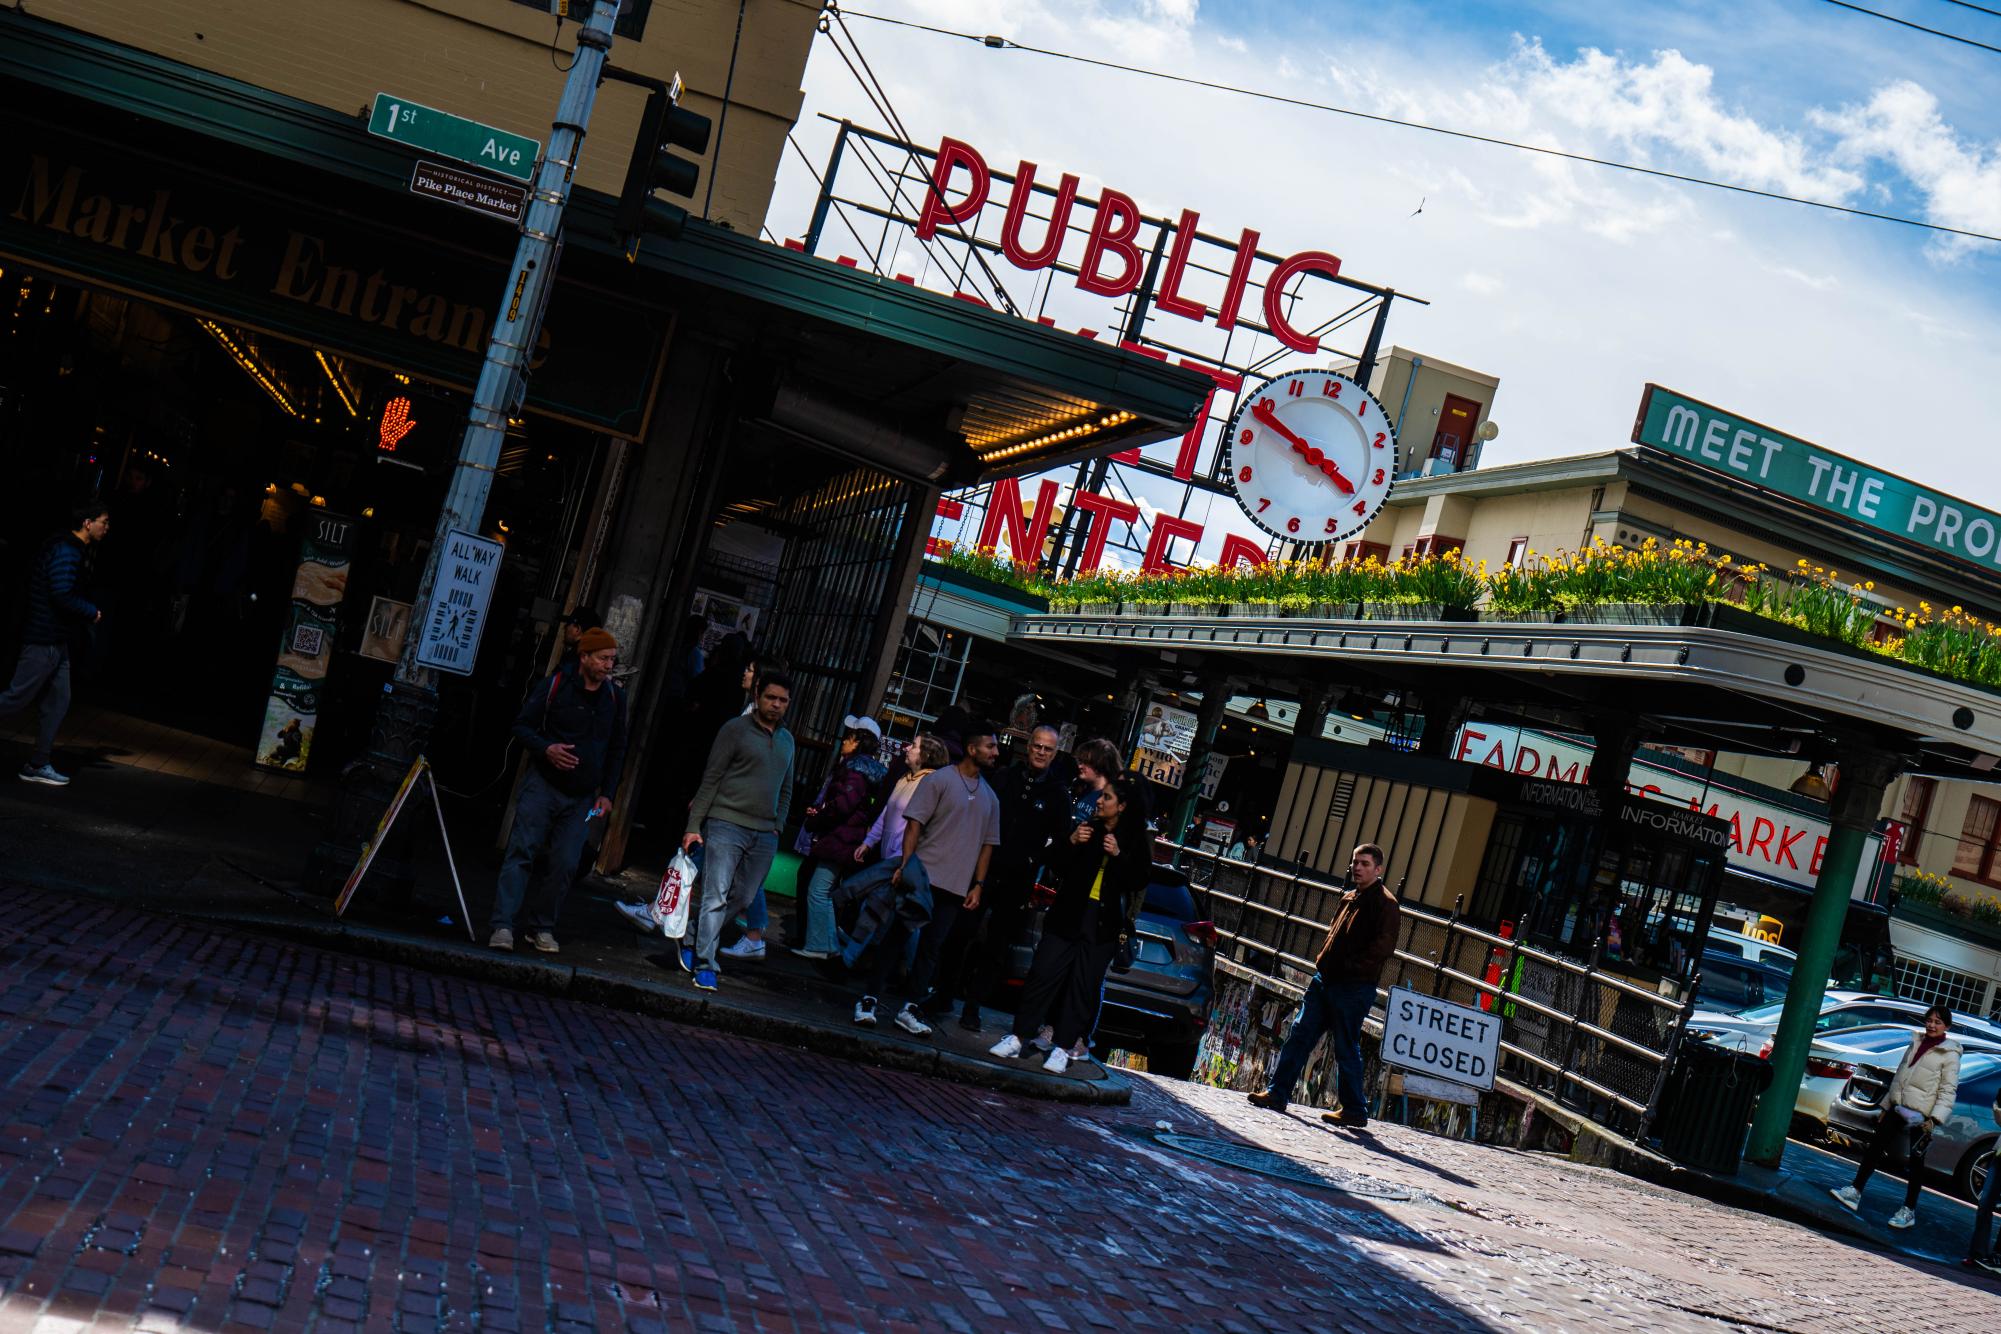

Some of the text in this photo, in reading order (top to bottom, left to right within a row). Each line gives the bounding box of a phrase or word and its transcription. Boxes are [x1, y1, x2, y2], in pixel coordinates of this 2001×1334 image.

[387, 103, 521, 166] 1st Ave
[433, 170, 508, 195] HISTORICAL DISTRICT
[416, 176, 518, 213] Pike Place Market
[915, 136, 1342, 355] PUBLIC
[8, 151, 554, 369] Market Entrane
[1289, 379, 1304, 397] 11
[1322, 380, 1342, 399] 12
[1358, 400, 1367, 416] 1
[1239, 429, 1254, 445] 9
[1373, 432, 1386, 448] 2
[1239, 465, 1253, 482] 8
[1372, 468, 1385, 485] 3
[1661, 404, 2001, 564] MEET THE PRO
[1257, 498, 1271, 512] 7
[1352, 500, 1366, 516] 4
[317, 520, 348, 545] SILT
[1287, 517, 1301, 533] 6
[1325, 518, 1338, 533] 5
[451, 541, 496, 566] ALL WAY
[454, 564, 482, 586] WALK
[372, 614, 402, 641] SILT
[1519, 782, 1587, 812] INFORMATION
[1620, 804, 1729, 848] INFORMATION
[1671, 810, 1705, 824] MARKET
[1400, 1000, 1489, 1043] STREET
[1393, 1033, 1486, 1077] CLOSED
